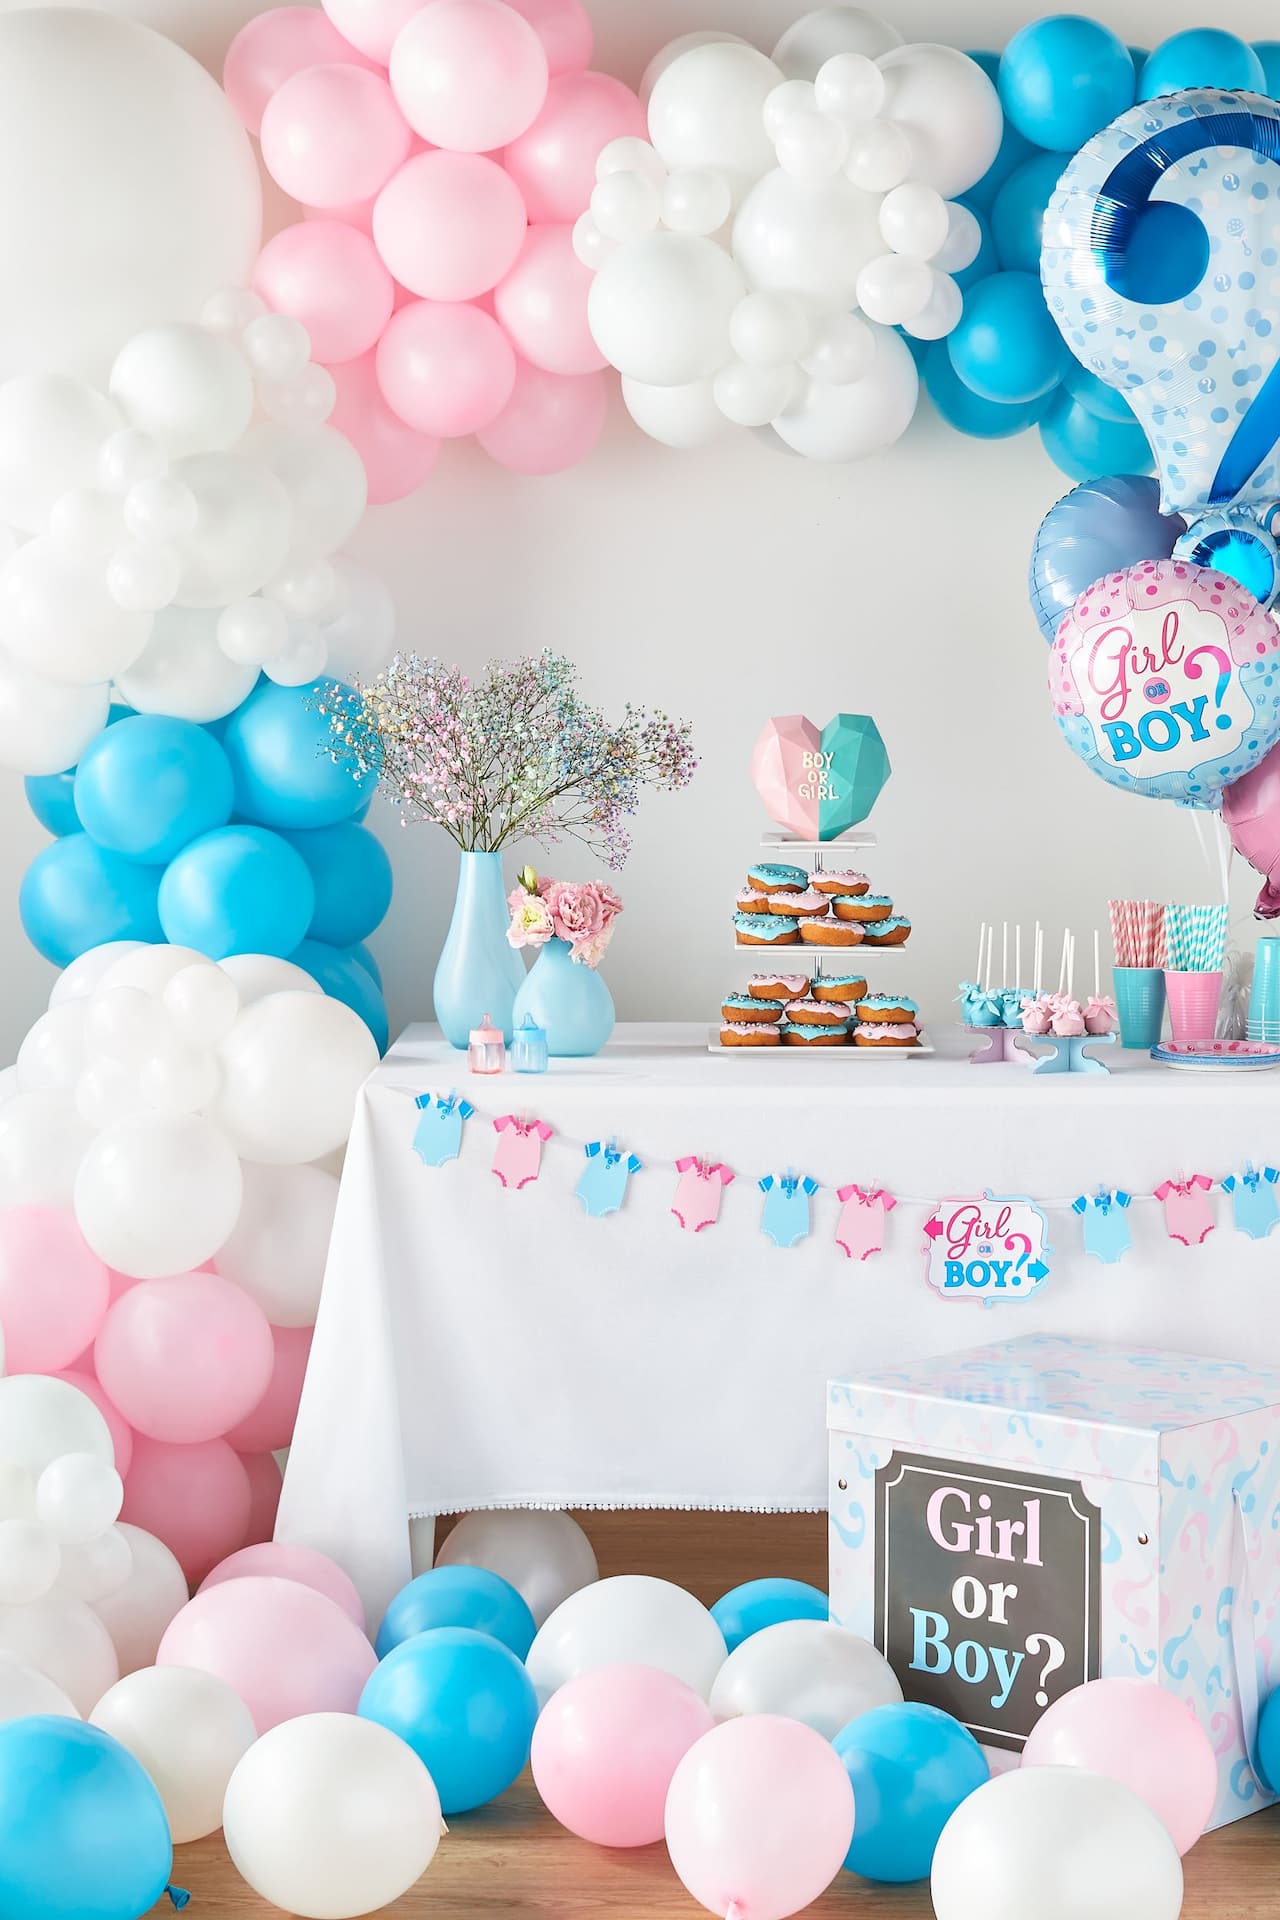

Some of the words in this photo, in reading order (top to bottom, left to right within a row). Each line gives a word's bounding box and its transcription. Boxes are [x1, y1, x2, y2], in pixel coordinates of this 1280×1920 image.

[1088, 611, 1185, 721] Girl
[1145, 682, 1168, 698] OR
[1101, 645, 1232, 762] BOY?
[803, 751, 834, 770] BOY
[807, 770, 828, 784] OR
[798, 783, 839, 800] GIRL
[946, 1205, 1011, 1260] Girl
[944, 1233, 1032, 1288] BOY?
[926, 1486, 1043, 1567] Girl
[951, 1575, 1018, 1625] or
[908, 1606, 1066, 1709] Boy?
